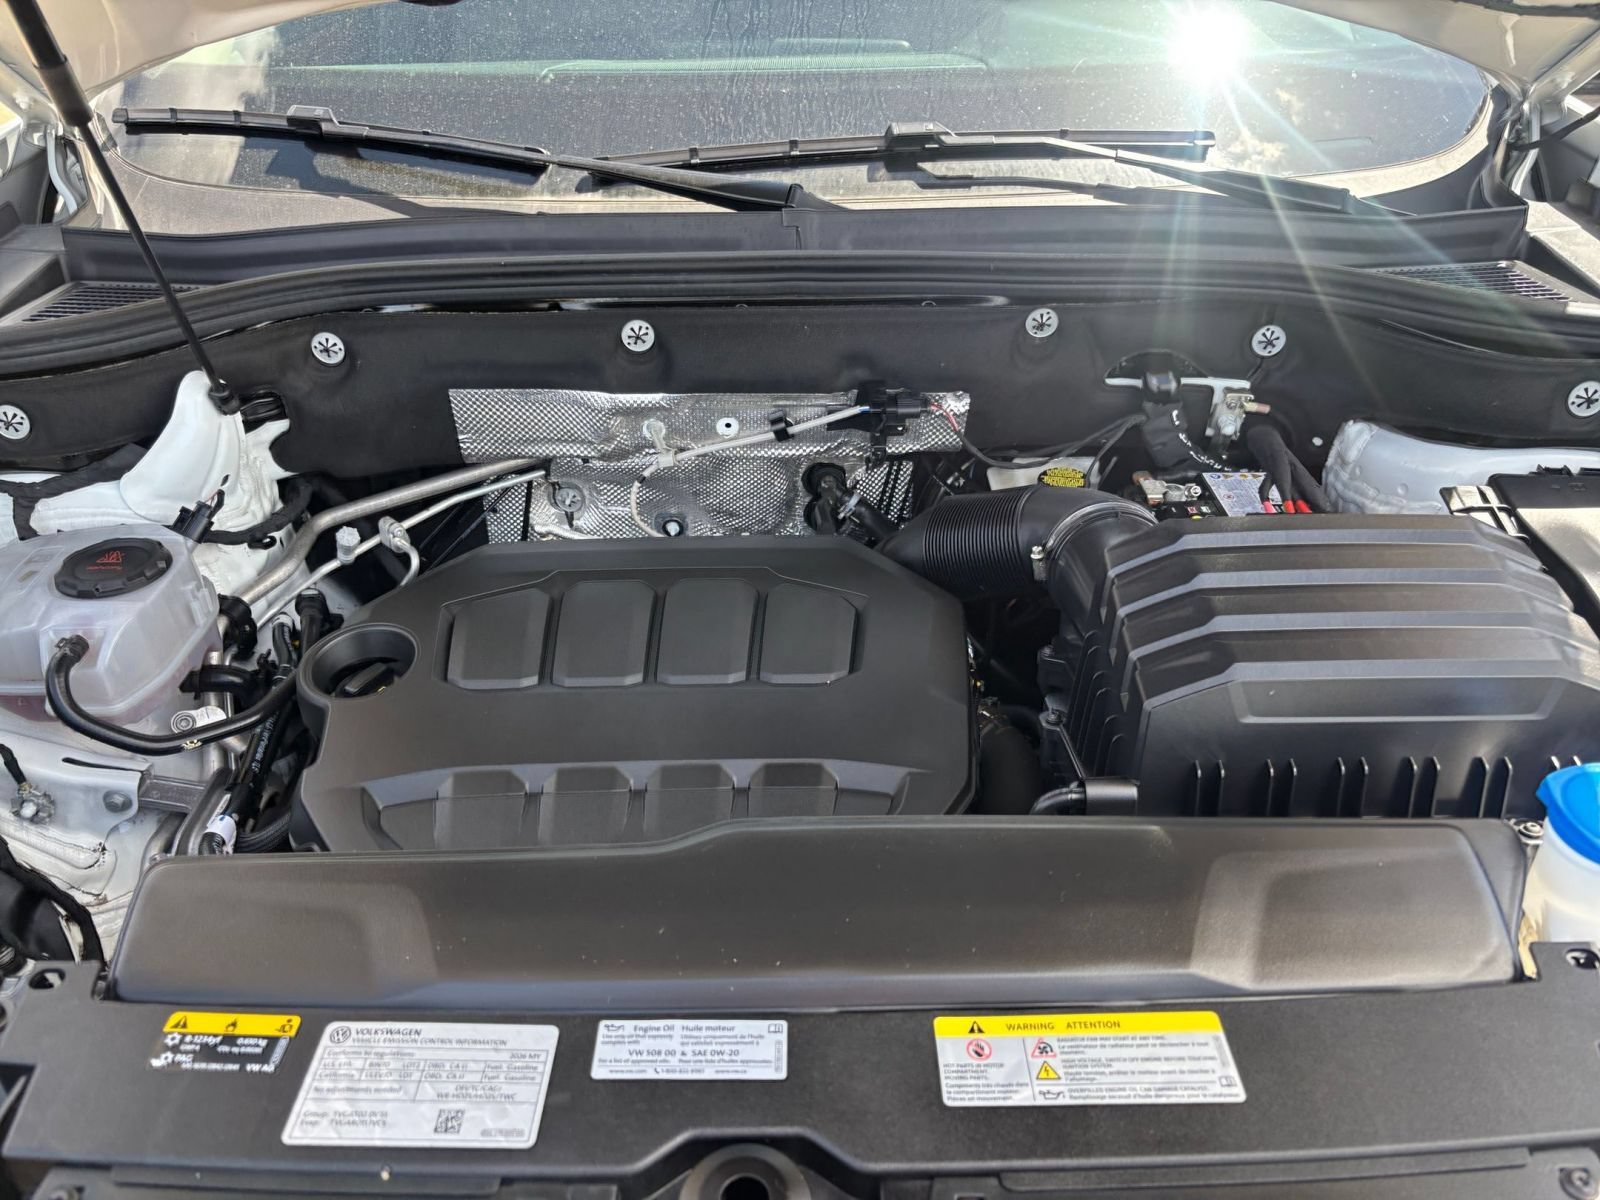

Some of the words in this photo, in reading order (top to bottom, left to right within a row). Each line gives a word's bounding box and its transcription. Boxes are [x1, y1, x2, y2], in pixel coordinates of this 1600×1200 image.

[633, 1024, 661, 1034] Engine
[662, 1024, 675, 1033] Oil
[681, 1024, 704, 1033] Huile
[705, 1025, 736, 1033] moteur
[1006, 1021, 1056, 1032] WARNING
[1066, 1019, 1121, 1031] ATTENTION
[355, 1027, 422, 1037] VOLKSWAGEN
[420, 1037, 453, 1046] CONTROL
[455, 1038, 508, 1047] INFORMATION
[628, 1049, 645, 1058] VW
[646, 1049, 663, 1058] 508
[664, 1049, 677, 1058] 00
[691, 1049, 708, 1058] SAE
[709, 1049, 741, 1058] 0W-20
